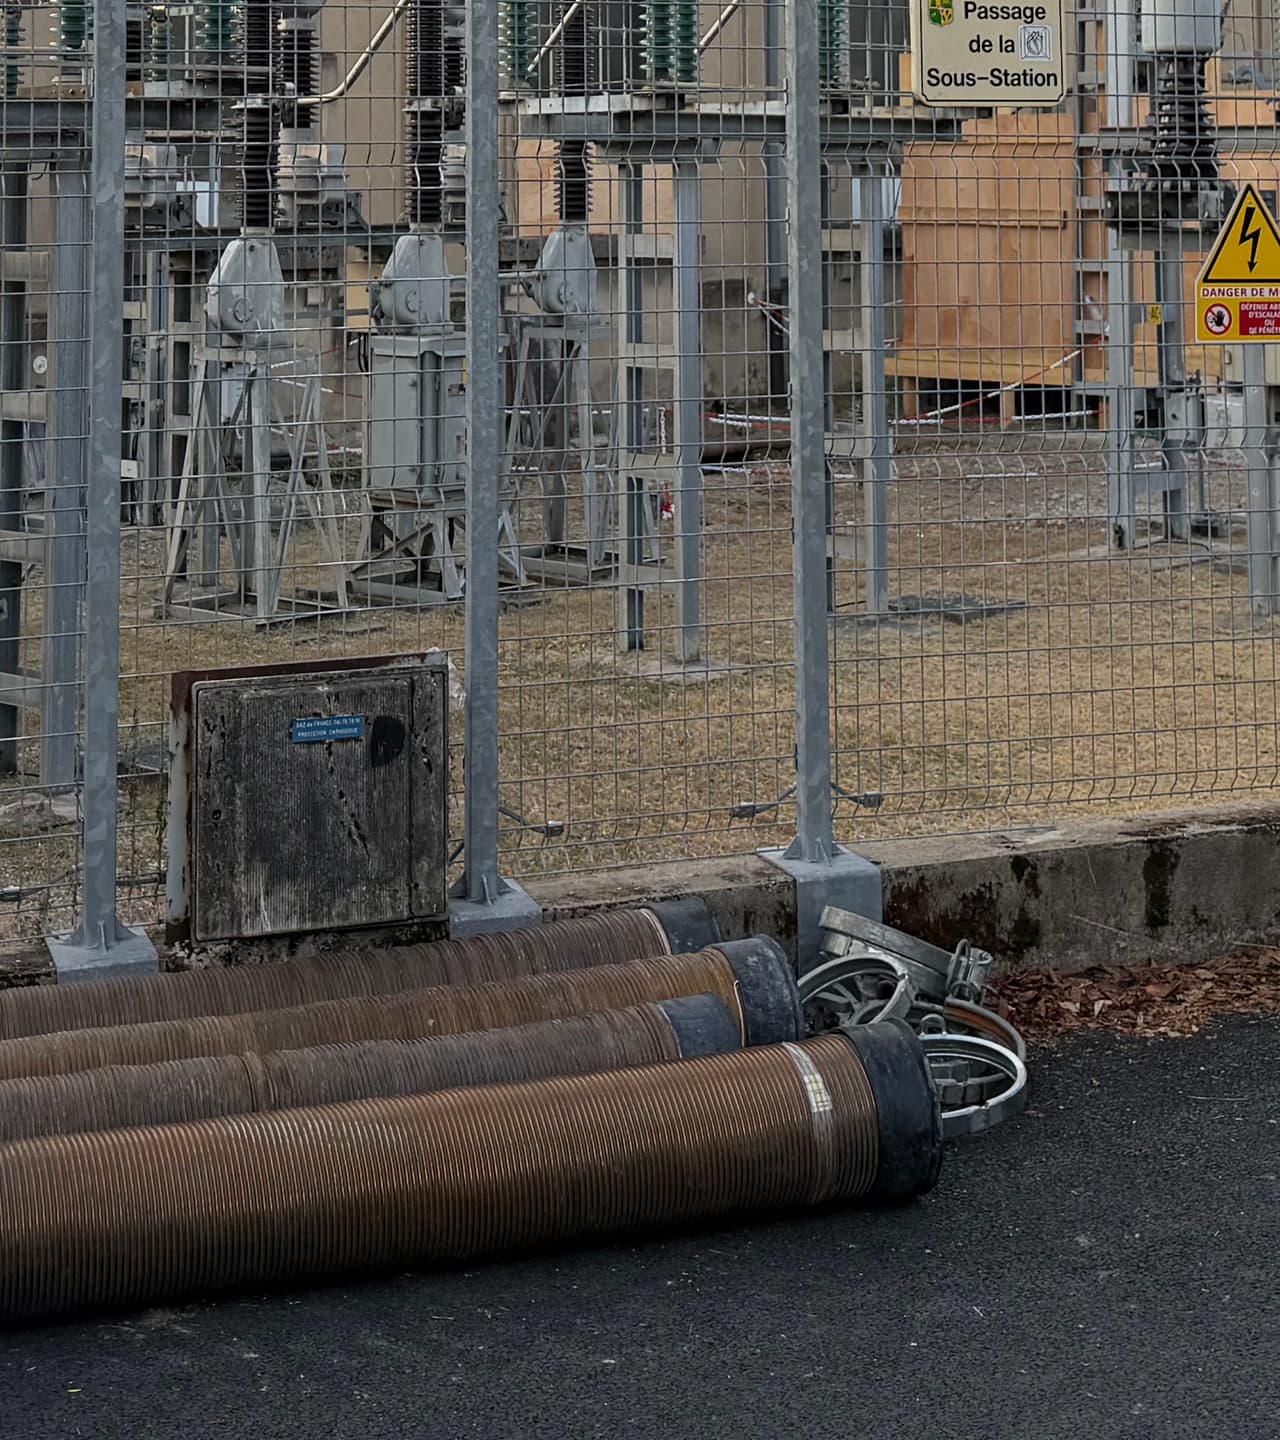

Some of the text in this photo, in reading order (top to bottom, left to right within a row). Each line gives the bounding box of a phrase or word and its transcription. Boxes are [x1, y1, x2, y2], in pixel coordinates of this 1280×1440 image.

[964, 1, 1046, 24] Passage
[969, 35, 1015, 53] de la
[927, 68, 1057, 86] Sous-Station
[1202, 288, 1247, 297] DANGER
[1252, 288, 1265, 296] DE
